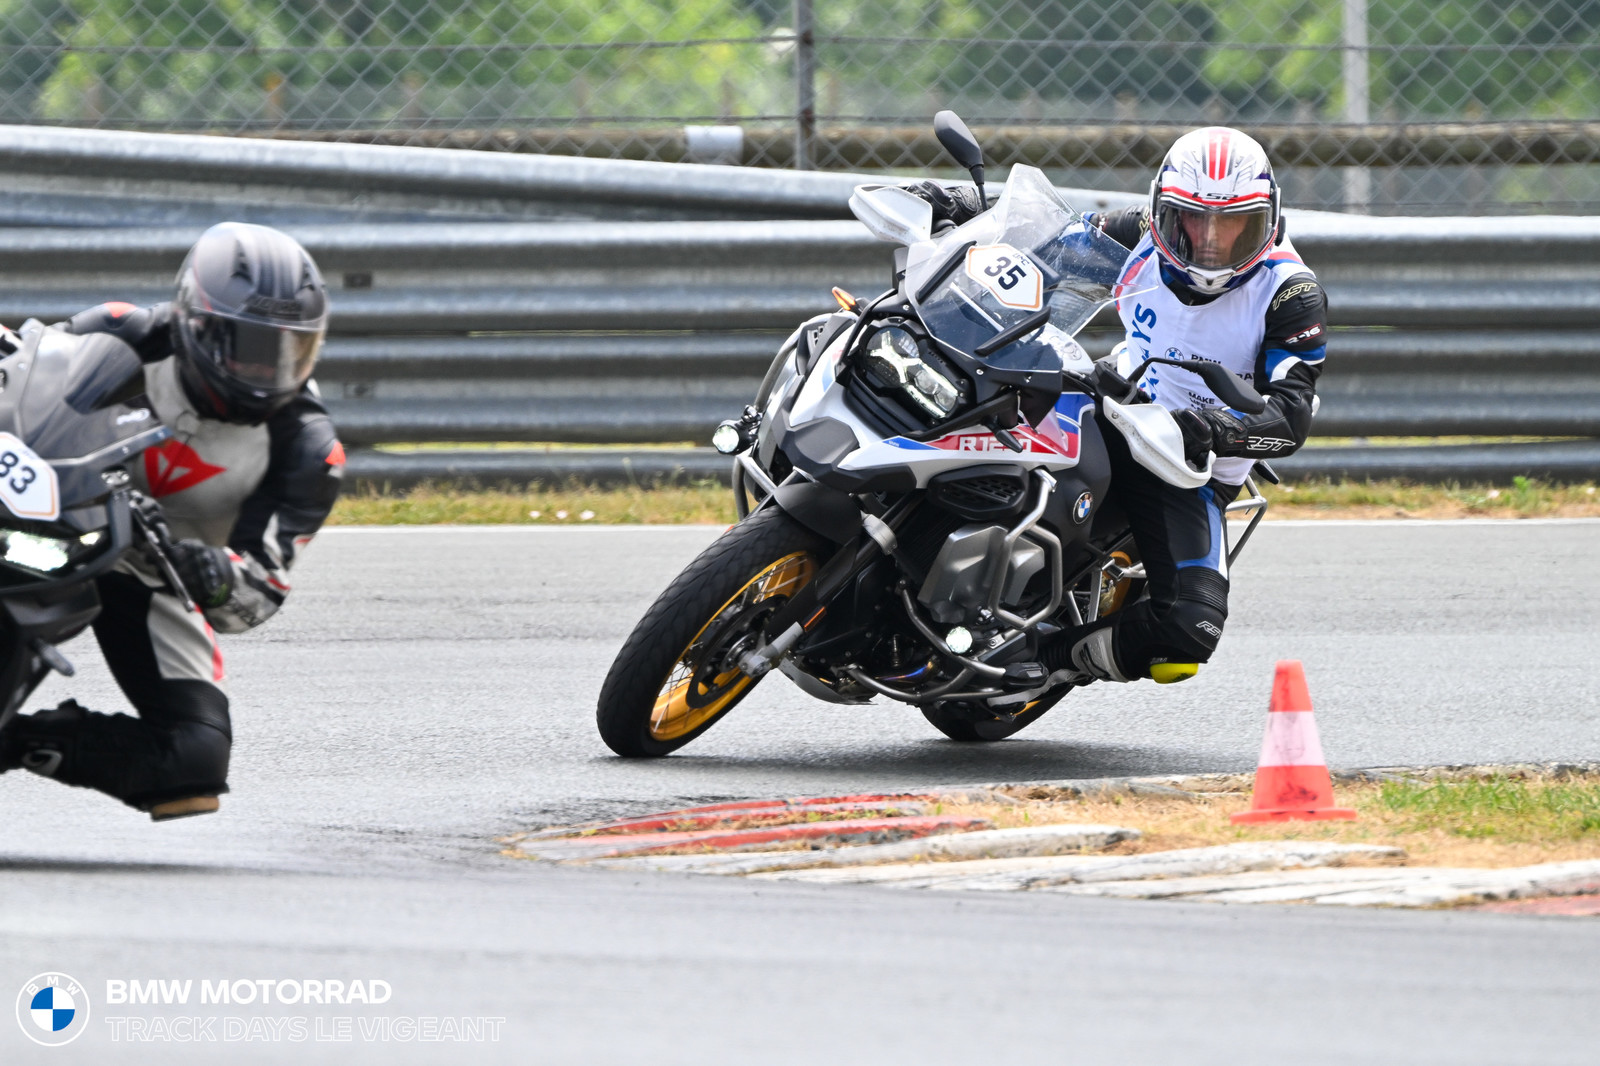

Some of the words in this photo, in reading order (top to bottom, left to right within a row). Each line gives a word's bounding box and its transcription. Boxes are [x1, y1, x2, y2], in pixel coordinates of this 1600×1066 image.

[984, 256, 1027, 290] 35
[1271, 282, 1317, 312] RST
[958, 436, 1032, 452] R120
[0, 451, 37, 494] 83
